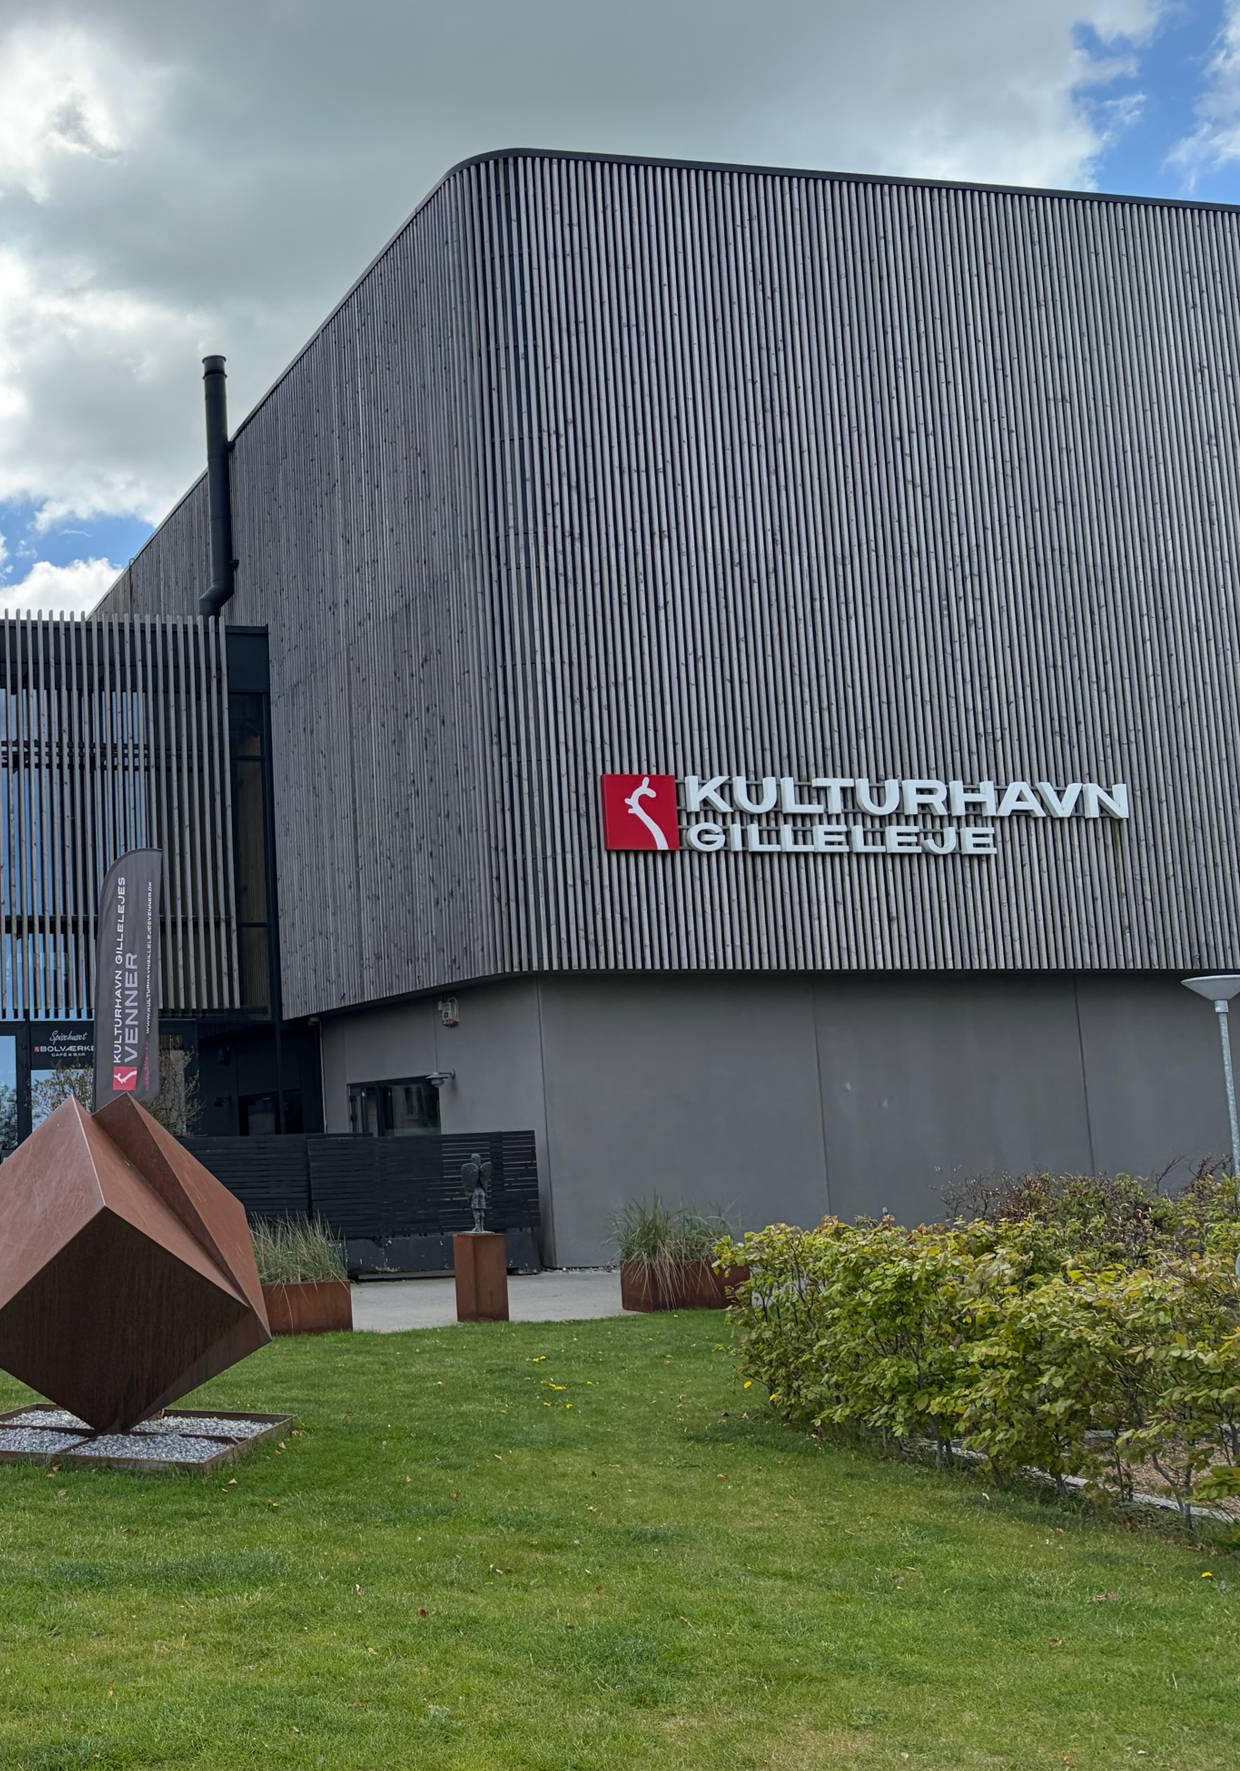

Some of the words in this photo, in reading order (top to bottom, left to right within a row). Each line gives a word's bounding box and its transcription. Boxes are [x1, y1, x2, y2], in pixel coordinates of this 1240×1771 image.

[684, 775, 1129, 819] KULTURHAVN
[686, 822, 998, 855] GILLELEJE
[114, 877, 126, 965] GILLELEJES
[113, 970, 123, 1063] KULTURHAVN
[124, 953, 138, 1063] VENNER
